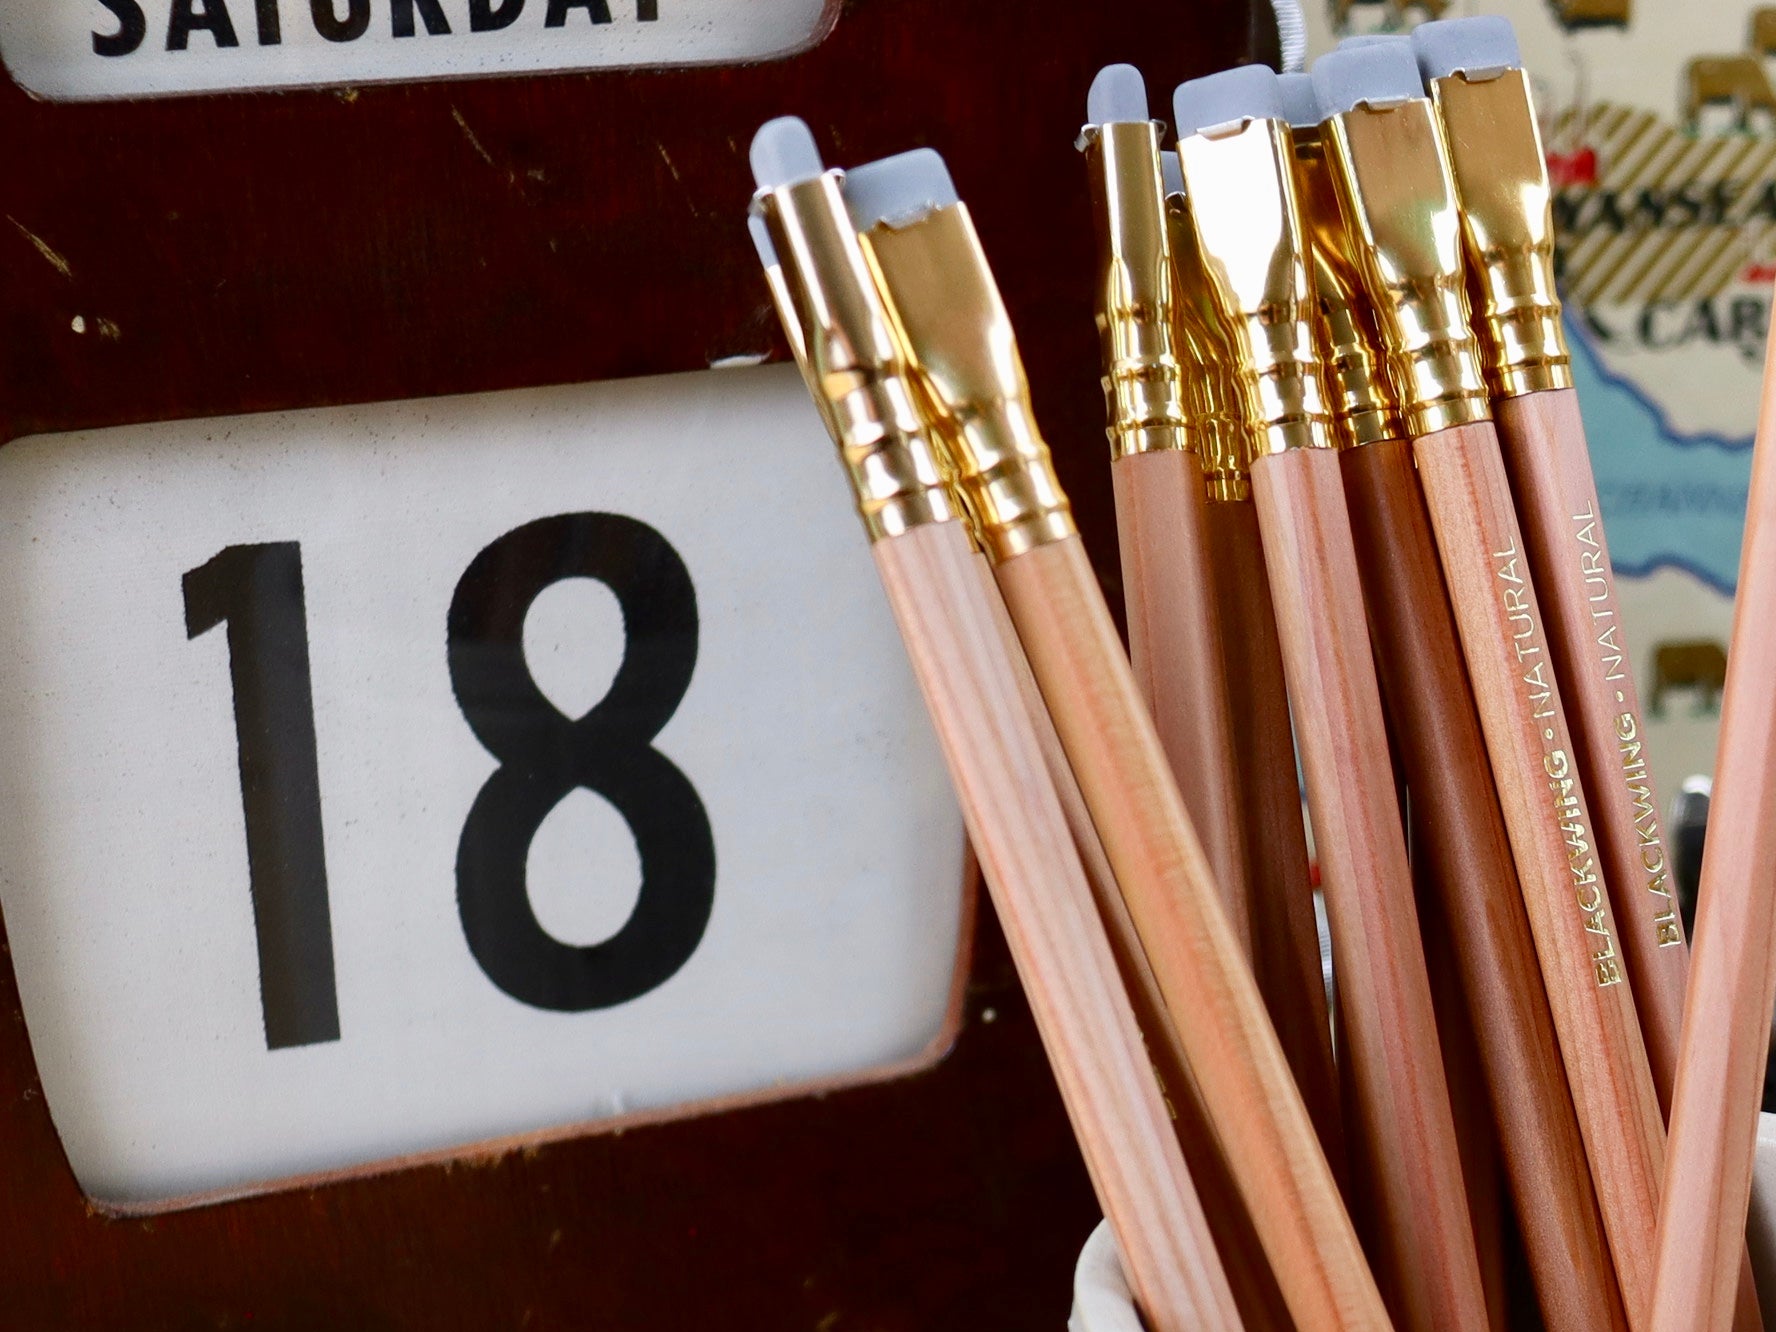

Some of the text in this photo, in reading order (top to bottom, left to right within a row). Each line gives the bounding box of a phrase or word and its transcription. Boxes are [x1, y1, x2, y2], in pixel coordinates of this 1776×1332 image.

[182, 511, 716, 1050] 18
[1493, 535, 1622, 988] BLACKWING NATURAL
[1572, 499, 1682, 949] BLACKWING NATURAL
